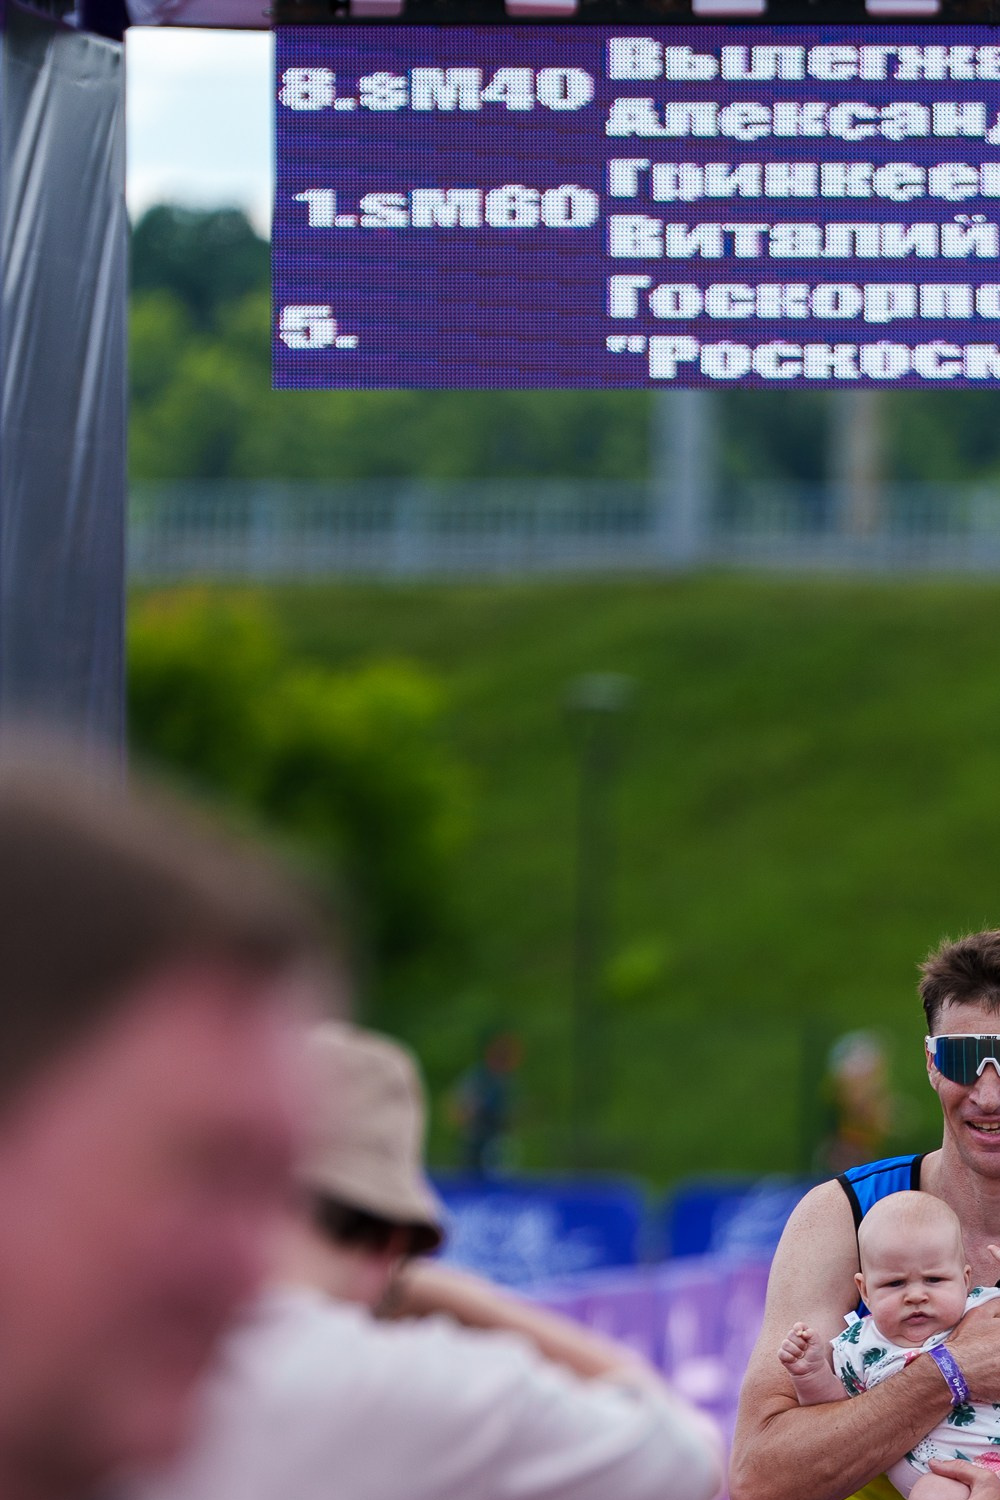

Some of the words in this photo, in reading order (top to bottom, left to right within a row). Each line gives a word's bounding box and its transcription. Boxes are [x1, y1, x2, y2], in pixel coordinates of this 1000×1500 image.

[277, 66, 596, 112] 8.sM40
[292, 183, 600, 229] 1.sM60
[607, 213, 1000, 259] Виталий
[277, 304, 359, 350] 5.
